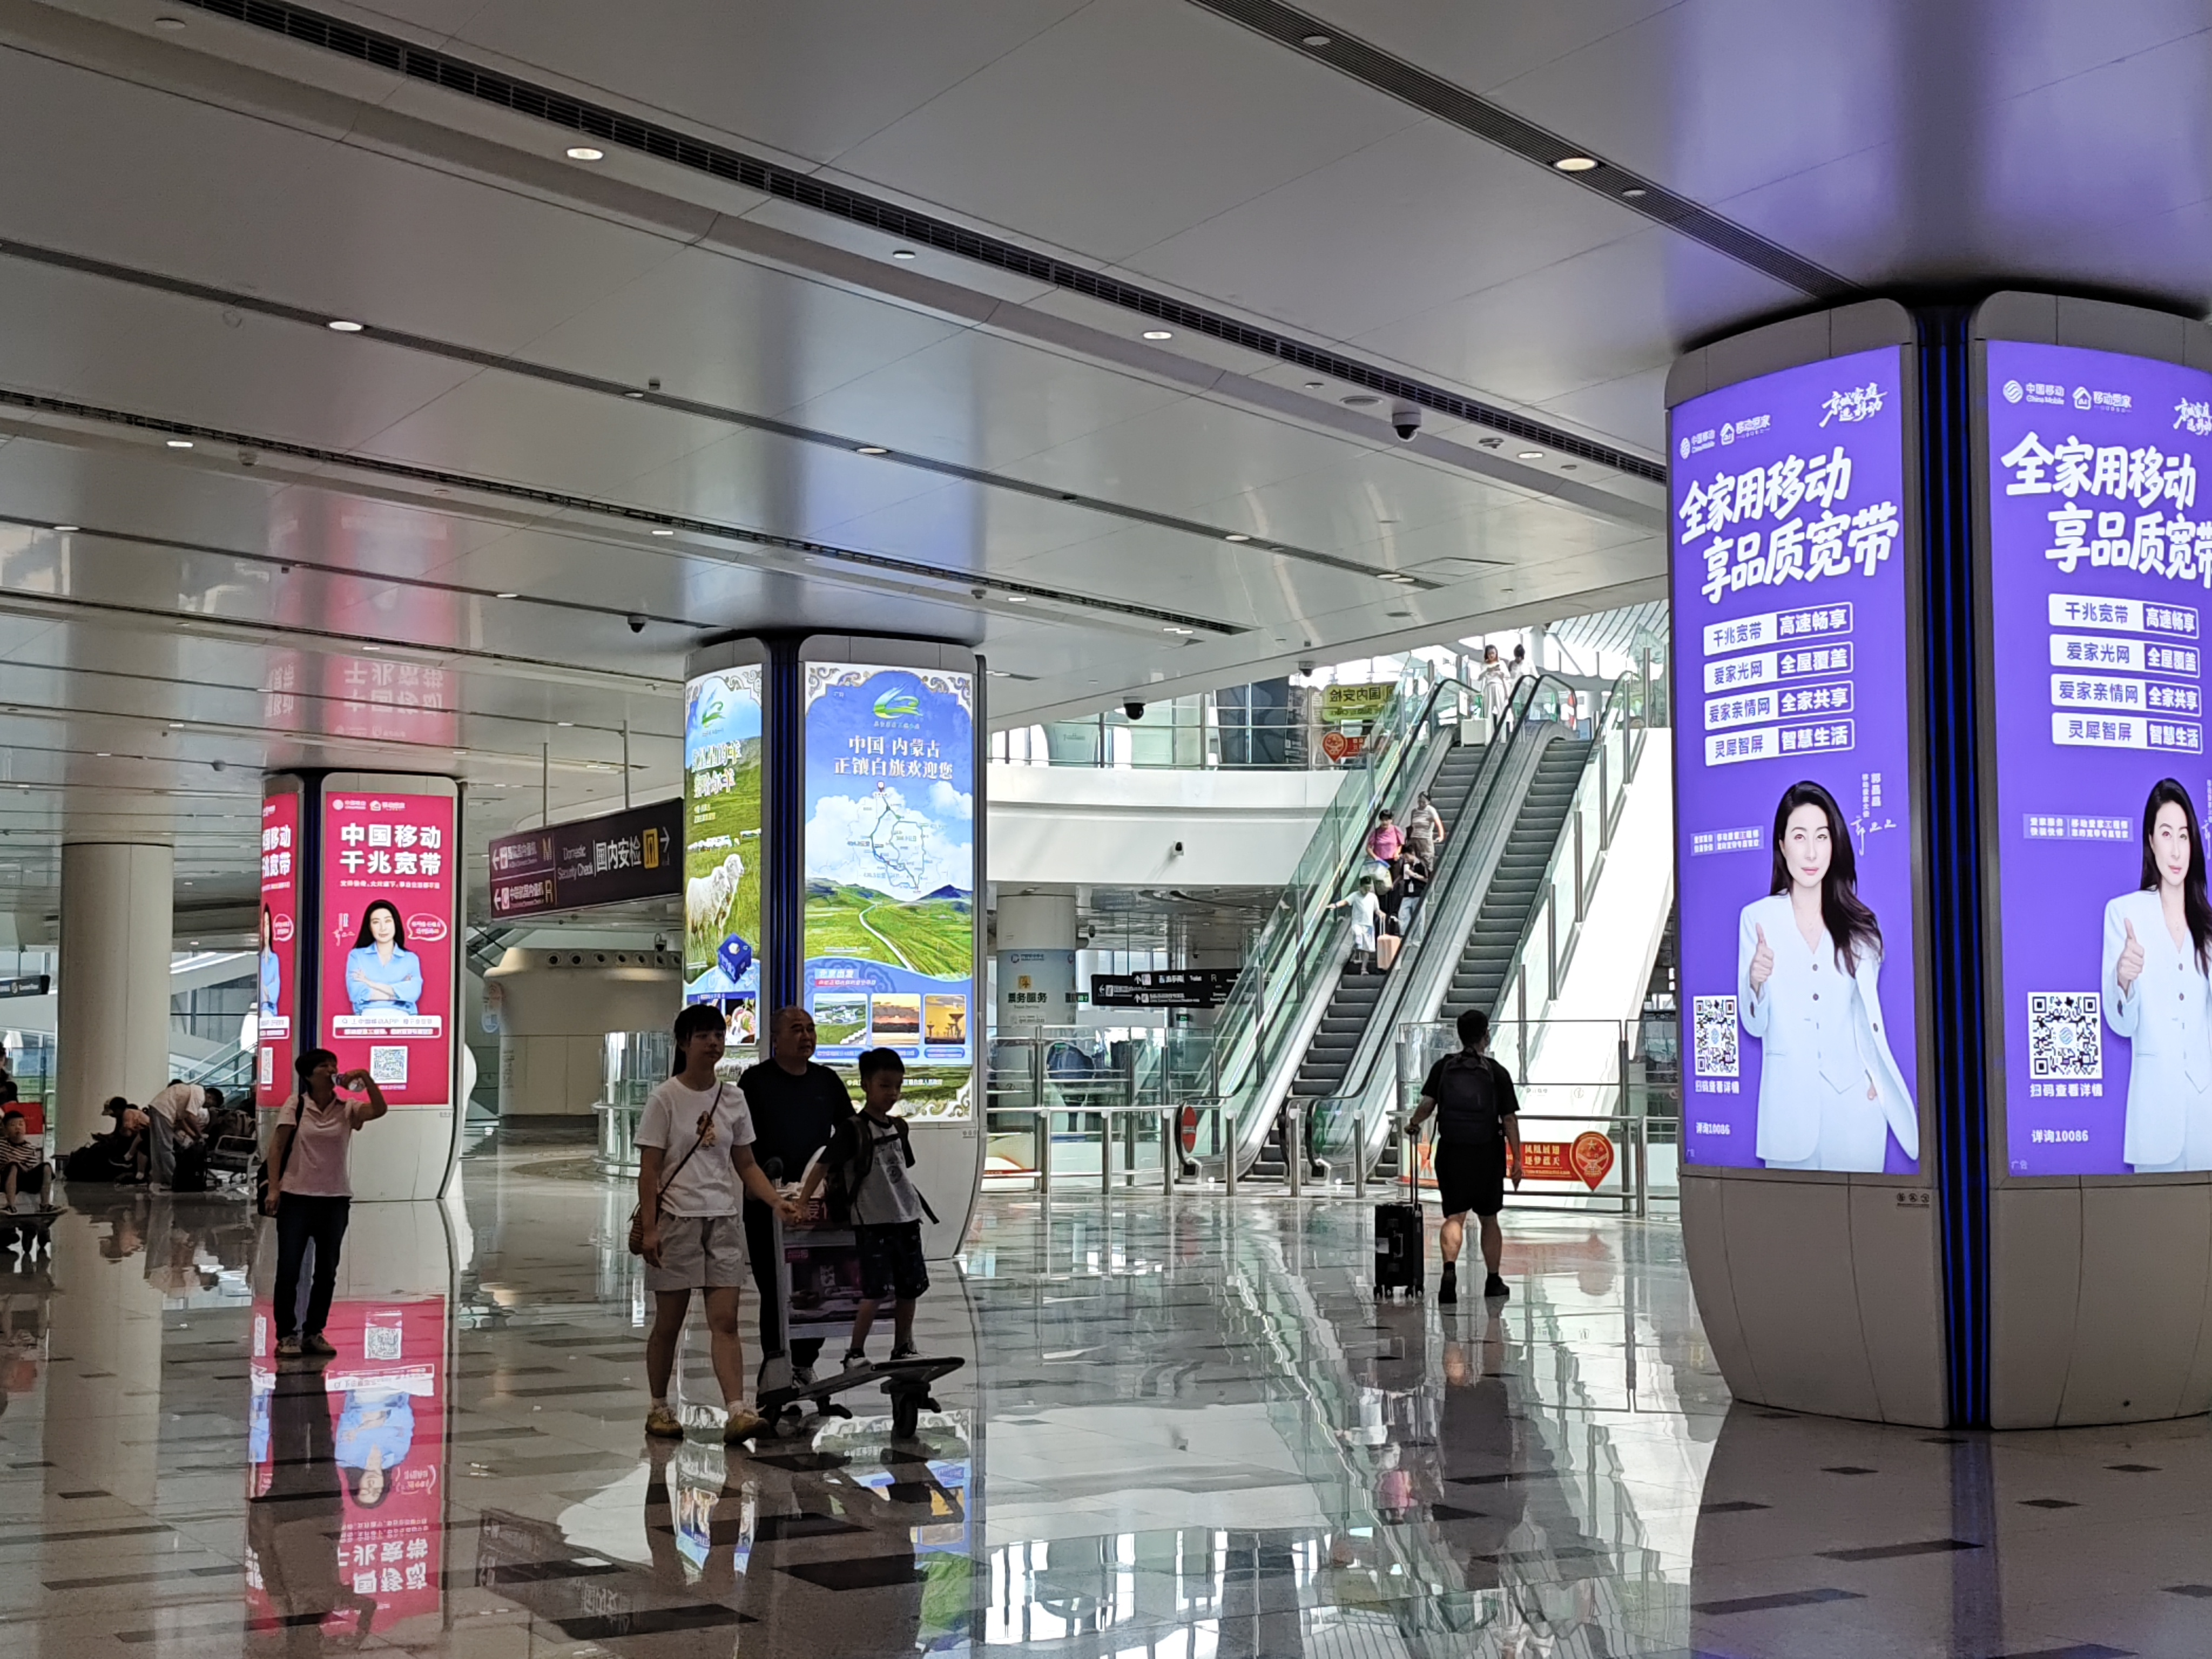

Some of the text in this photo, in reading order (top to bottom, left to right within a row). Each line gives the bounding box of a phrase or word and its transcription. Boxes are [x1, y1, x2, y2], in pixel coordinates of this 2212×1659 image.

[2026, 383, 2065, 397] 中国移动
[2001, 431, 2196, 511] 全家用移动
[1678, 446, 1852, 545] 全家用移动
[1701, 501, 1899, 604] 享品质宽带
[1779, 608, 1847, 636] 高速畅享
[2065, 602, 2129, 624] 千兆宽带
[2146, 607, 2196, 632] 高速畅享
[1713, 622, 1762, 648] 千兆宽带
[1781, 648, 1847, 675] 全屋覆盖
[2066, 642, 2130, 664] 爱家光网
[2147, 647, 2197, 672] 全屋覆盖
[1714, 660, 1763, 685] 爱家光网
[1781, 687, 1848, 713] 全家共享
[2059, 681, 2139, 704] 爱家亲情网
[2149, 686, 2198, 711] 全家共享
[1709, 697, 1770, 723] 爱家亲情网
[1782, 725, 1849, 751] 智慧生活
[2068, 720, 2132, 741] 灵犀智屏
[2149, 724, 2199, 748] 智慧生活
[848, 734, 941, 758] 中国 内蒙古
[1715, 734, 1764, 759] 灵犀智屏
[833, 757, 953, 780] 正镶白旗欢迎您
[340, 822, 441, 849] 中国移动
[339, 850, 442, 876] 千兆宽带
[596, 835, 642, 872] 国内安检
[545, 880, 554, 904] R
[1008, 992, 1048, 1003] 票务服务
[1695, 1080, 1740, 1094] 扫码查看详情
[2029, 1083, 2103, 1097] 扫码查看详情
[1696, 1122, 1731, 1135] 详询10086
[2031, 1129, 2089, 1143] 详询10086
